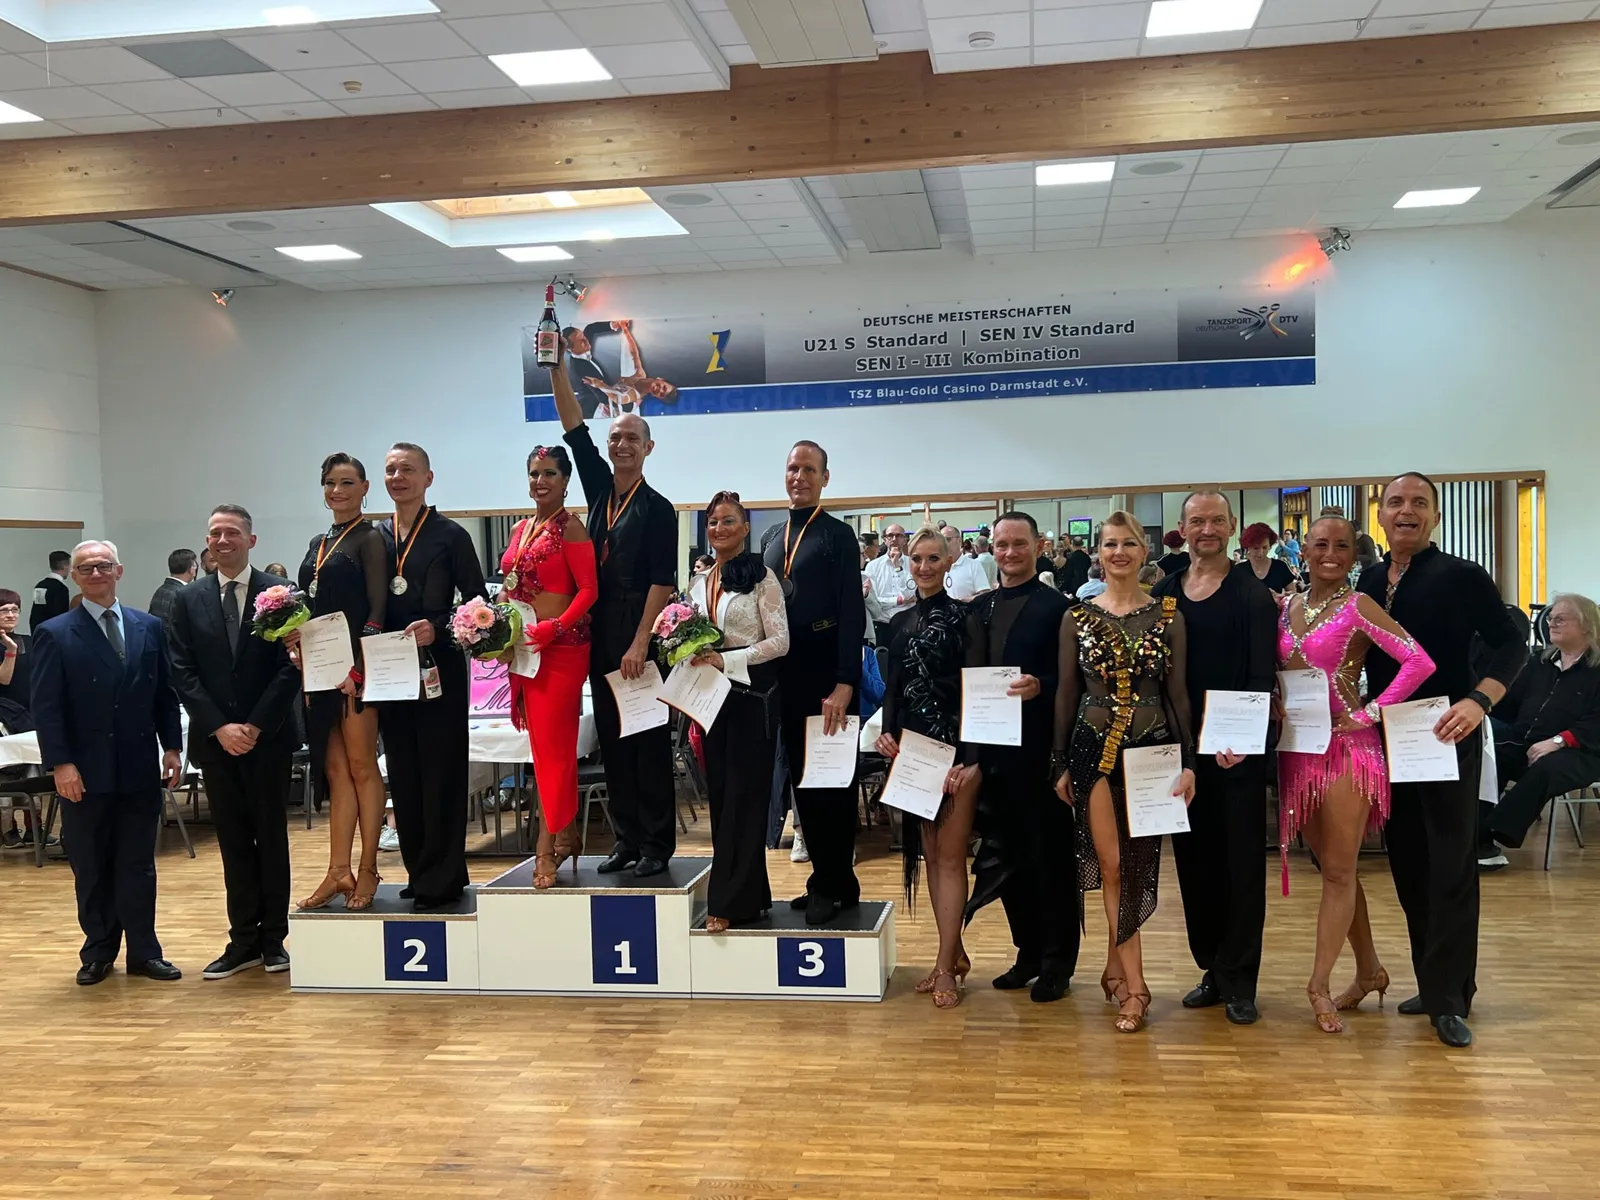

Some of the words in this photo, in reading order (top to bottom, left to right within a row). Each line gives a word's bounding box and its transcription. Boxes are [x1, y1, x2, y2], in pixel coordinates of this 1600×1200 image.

[863, 313, 934, 328] DEUTSCHE
[938, 305, 1071, 322] MEISTERSCHAFTEN
[1196, 323, 1240, 332] DEUTSCHLAND
[1207, 317, 1252, 326] TANZSPORT
[1279, 315, 1298, 324] DTV
[804, 338, 838, 352] U21
[844, 337, 855, 350] S
[866, 331, 948, 349] Standard
[979, 326, 1016, 342] SEN
[1022, 325, 1044, 340] IV
[1049, 320, 1135, 338] Standard
[856, 356, 891, 372] SEN
[897, 356, 906, 370] I
[925, 353, 951, 368] III
[962, 347, 1080, 366] Kombination
[849, 389, 872, 399] TSZ
[876, 385, 938, 398] Blau-Gold
[943, 383, 985, 394] Casino
[990, 379, 1059, 391] Darmstadt
[1063, 377, 1088, 388] e.V.
[402, 938, 430, 973] 2
[613, 940, 638, 975] 1
[797, 941, 826, 977] 3
